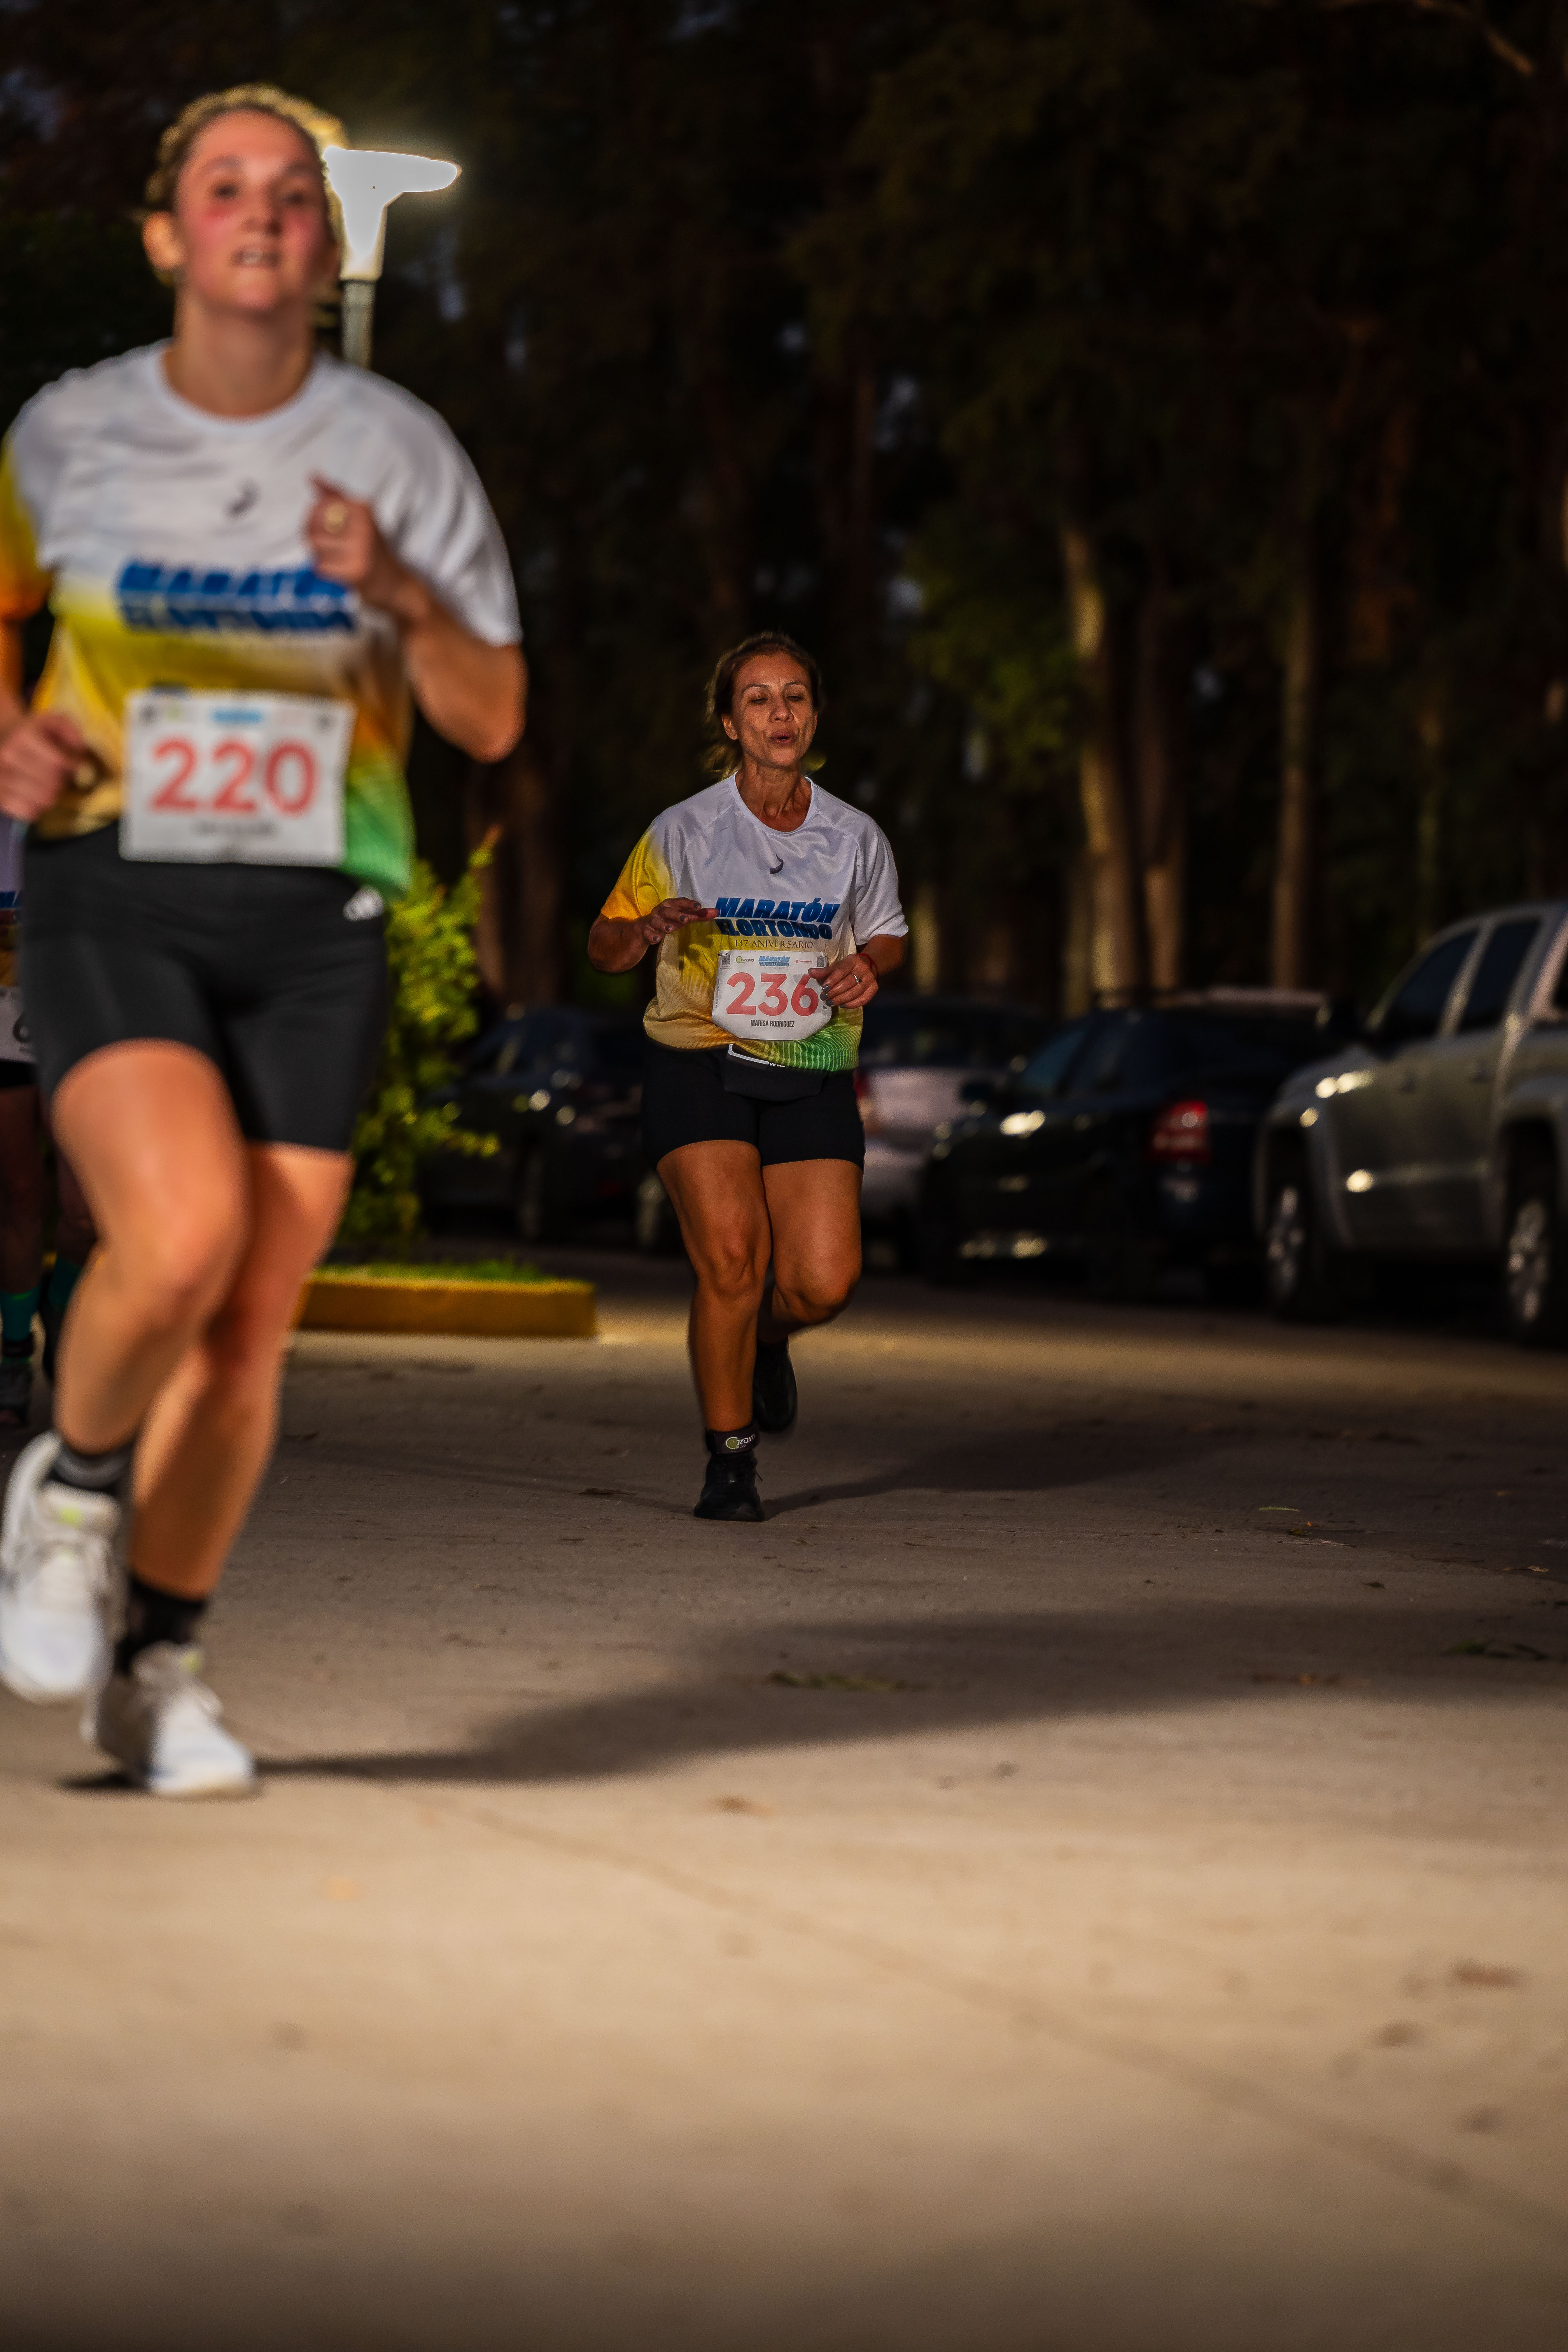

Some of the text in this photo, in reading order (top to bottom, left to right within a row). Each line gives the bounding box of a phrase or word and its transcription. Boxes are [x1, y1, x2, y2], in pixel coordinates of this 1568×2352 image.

[151, 736, 318, 818] 220
[715, 897, 840, 923] MARATÓN
[714, 919, 833, 940] ELORTONDO
[751, 940, 813, 949] ANIVERSARIO
[726, 972, 819, 1017] 236
